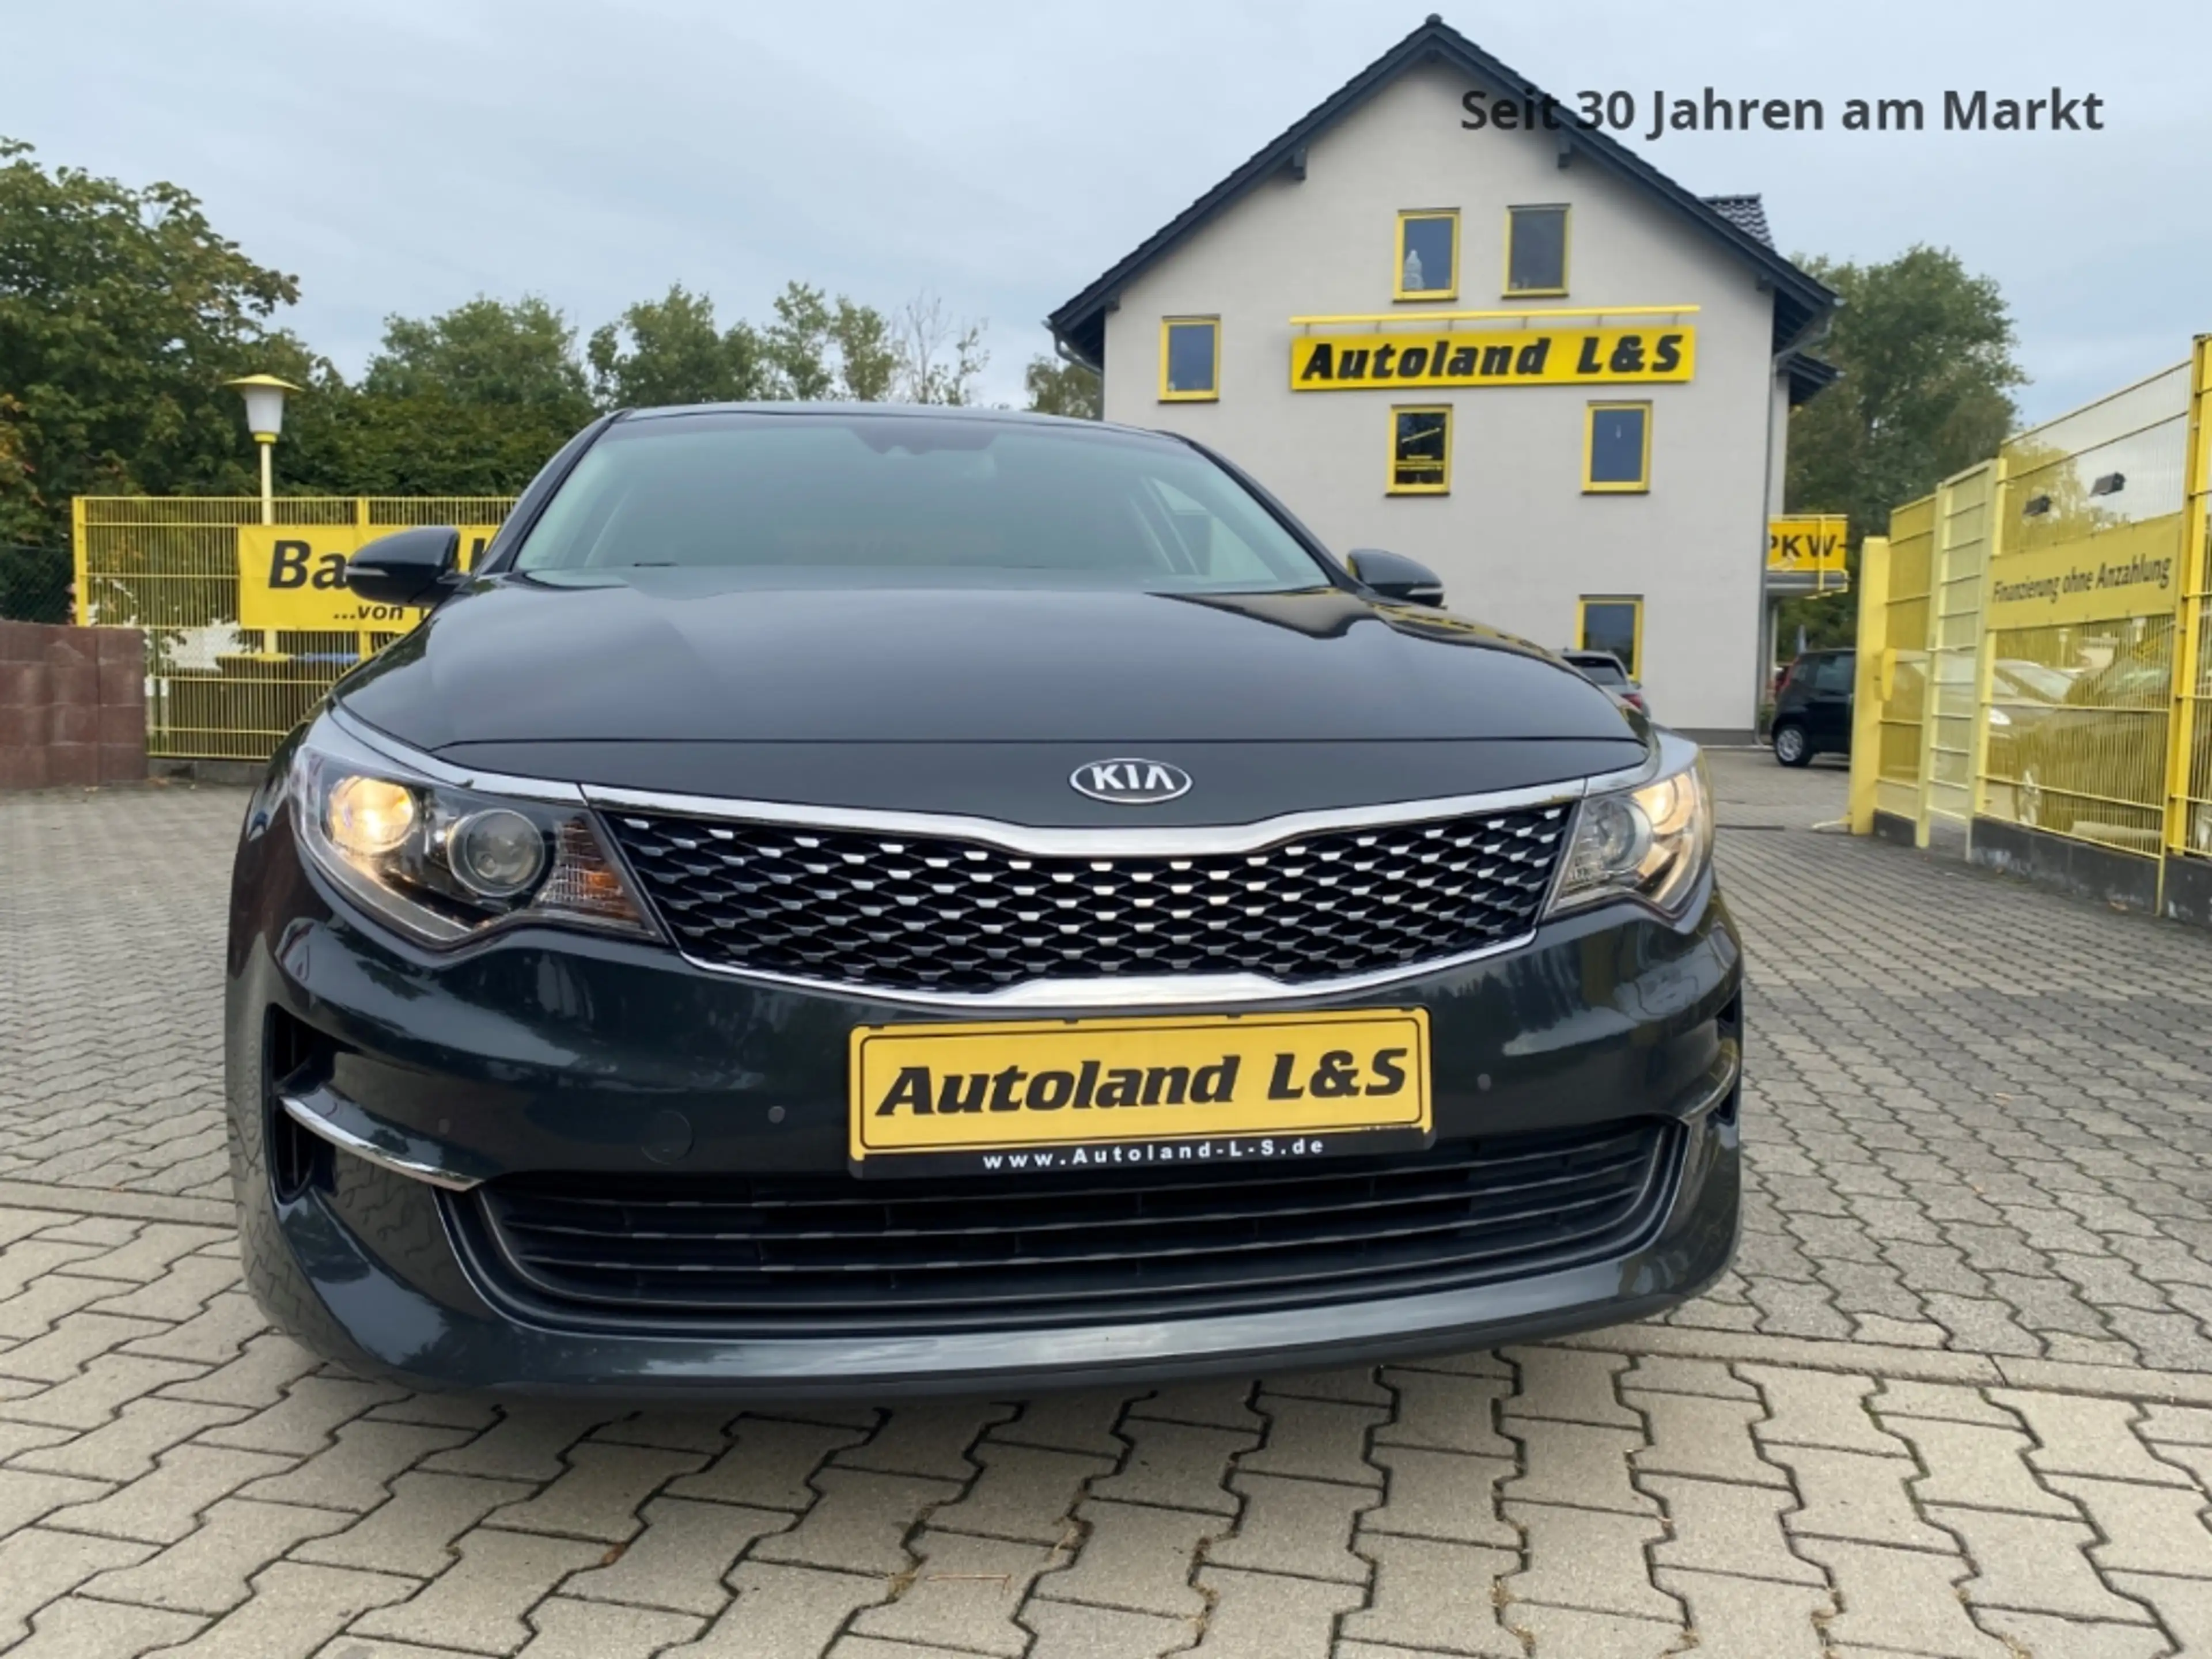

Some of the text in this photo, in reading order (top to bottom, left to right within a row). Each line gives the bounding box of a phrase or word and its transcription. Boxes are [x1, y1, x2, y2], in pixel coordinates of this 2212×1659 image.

[1300, 334, 1683, 381] Autoland L&S
[1992, 552, 2172, 604] Finanzierung ohne Anzahlung
[1090, 764, 1176, 791] KIA
[874, 1047, 1408, 1116] Autoland L&S
[983, 1137, 1325, 1169] www.Autoland-L-S.de
